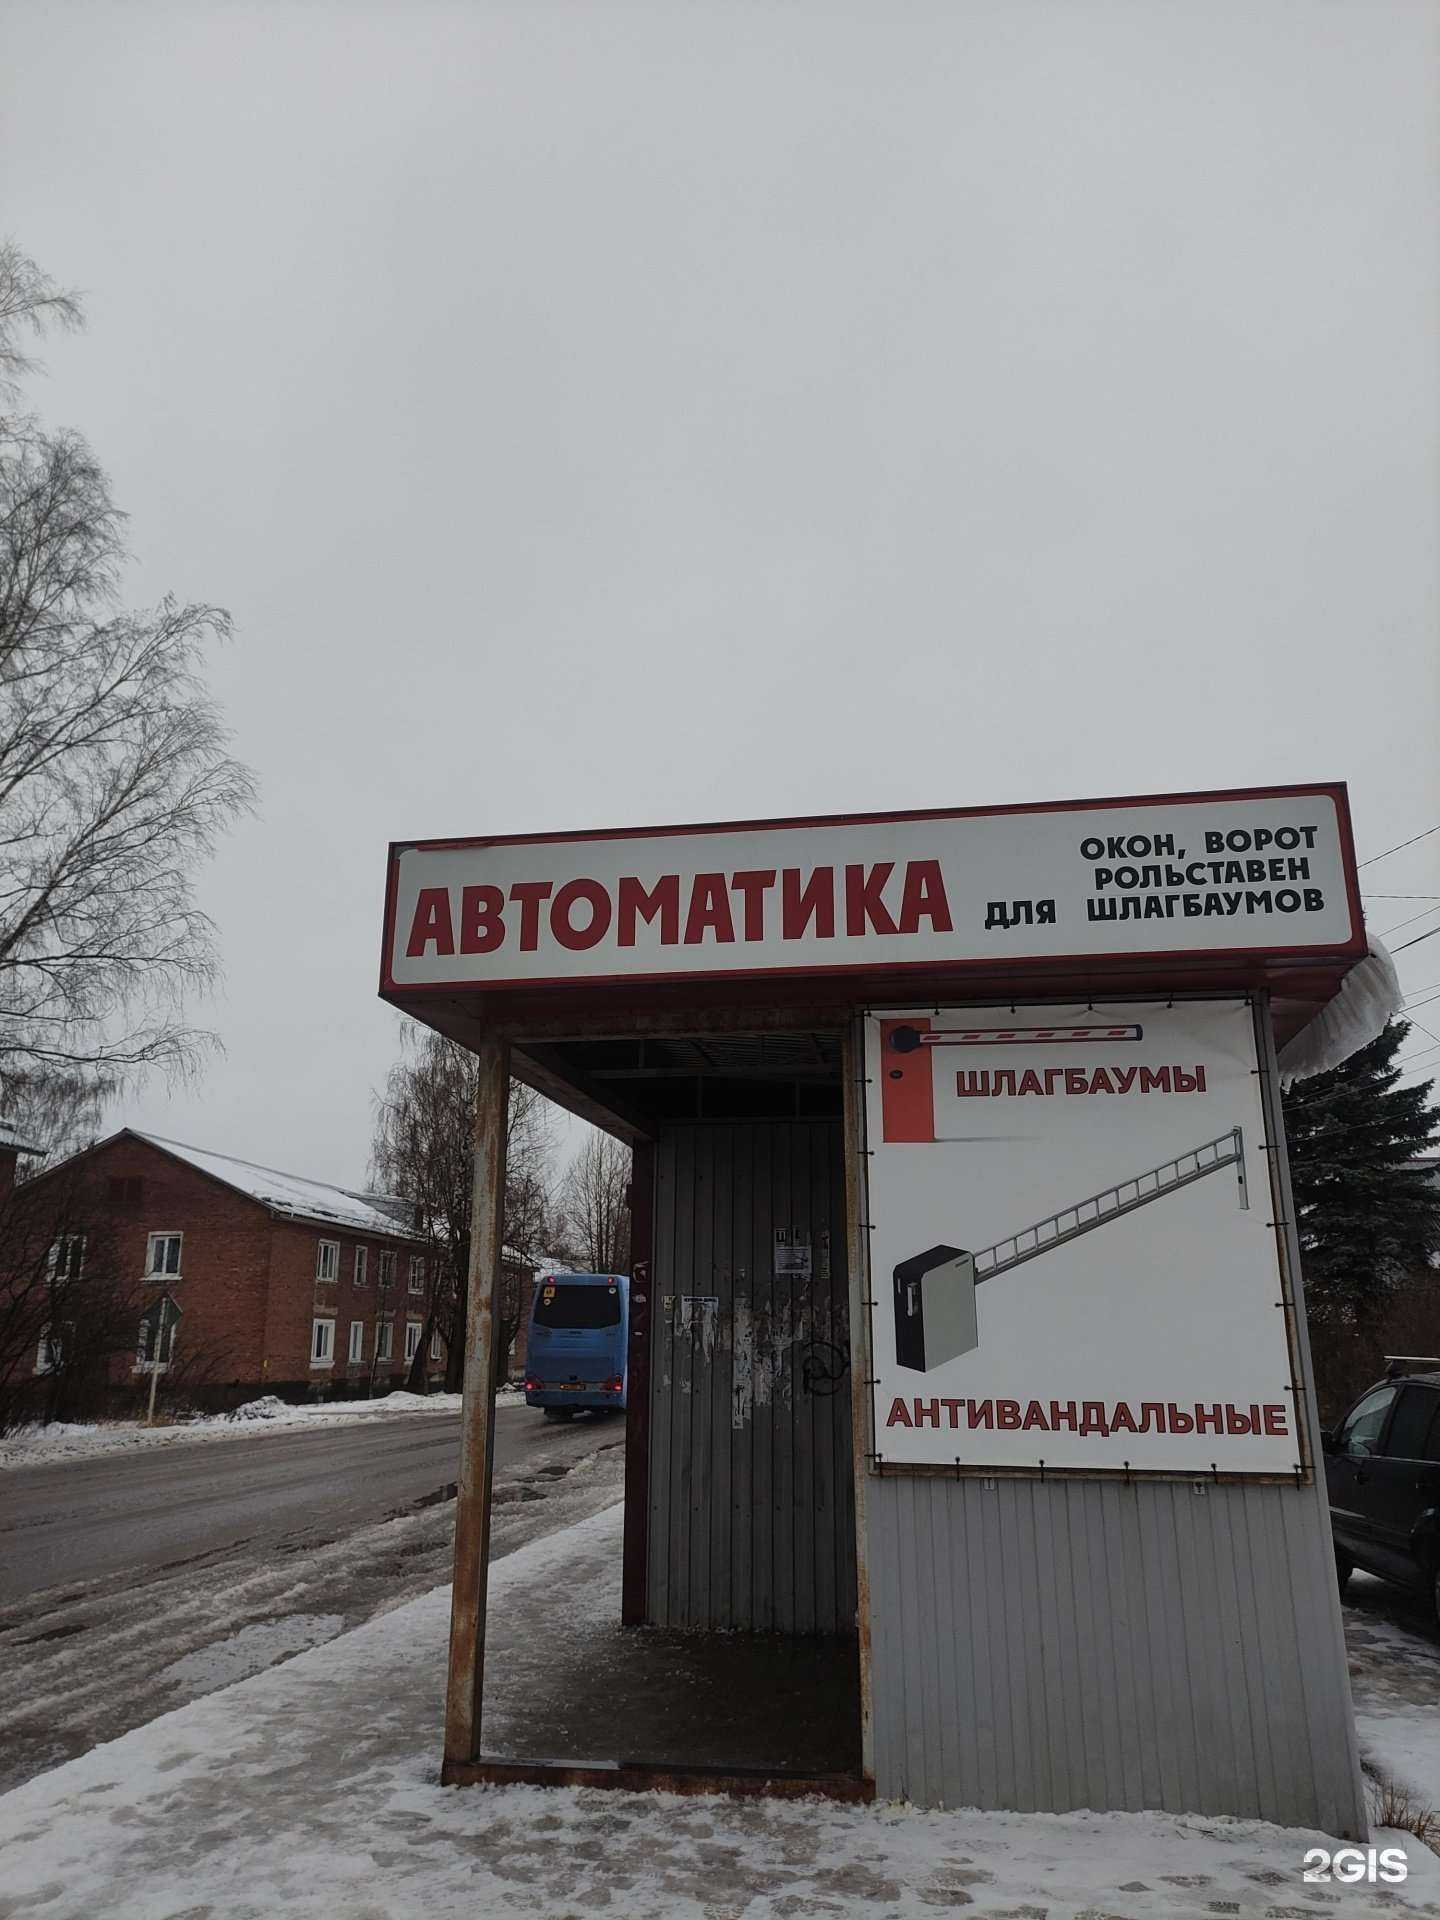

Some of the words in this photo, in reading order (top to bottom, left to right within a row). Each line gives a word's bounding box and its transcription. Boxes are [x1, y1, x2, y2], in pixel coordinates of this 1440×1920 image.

[1080, 834, 1187, 860] ОКОН,
[1204, 826, 1318, 854] ВОРОТ
[1095, 857, 1311, 890] РОЛЬСТАВЕН
[406, 859, 953, 957] АВТОМАТИКА
[985, 900, 1056, 930] ДЛЯ
[1087, 888, 1325, 922] ШЛАГБАУМОВ
[956, 1065, 1207, 1098] ШЛАГБАУМЫ
[886, 1397, 1289, 1437] АНТИВАНДАЛЬНЫЕ
